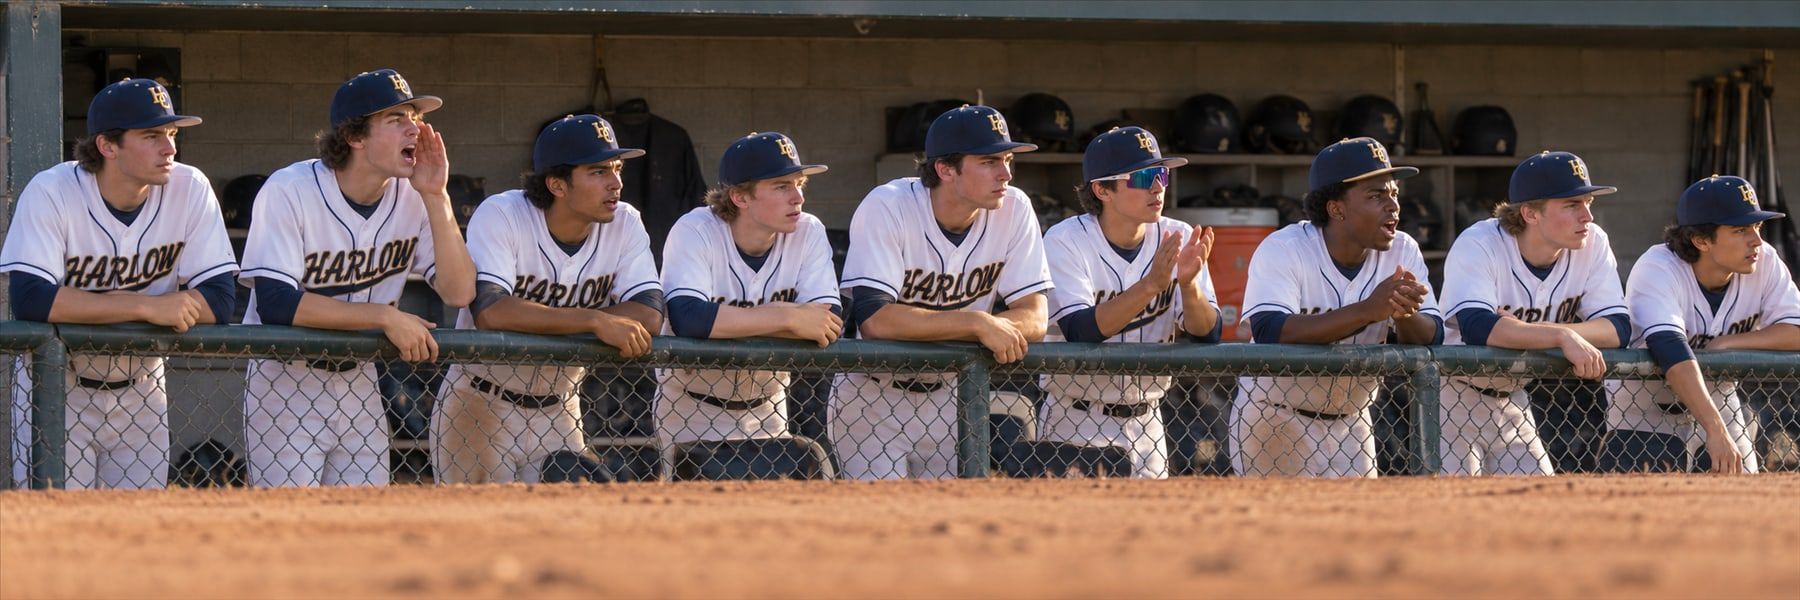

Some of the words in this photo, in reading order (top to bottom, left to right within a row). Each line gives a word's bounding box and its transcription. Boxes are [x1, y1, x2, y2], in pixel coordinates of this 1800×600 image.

[65, 242, 184, 287] HARLOW
[302, 237, 418, 284] HARLOW
[902, 262, 1004, 303] HARLOW
